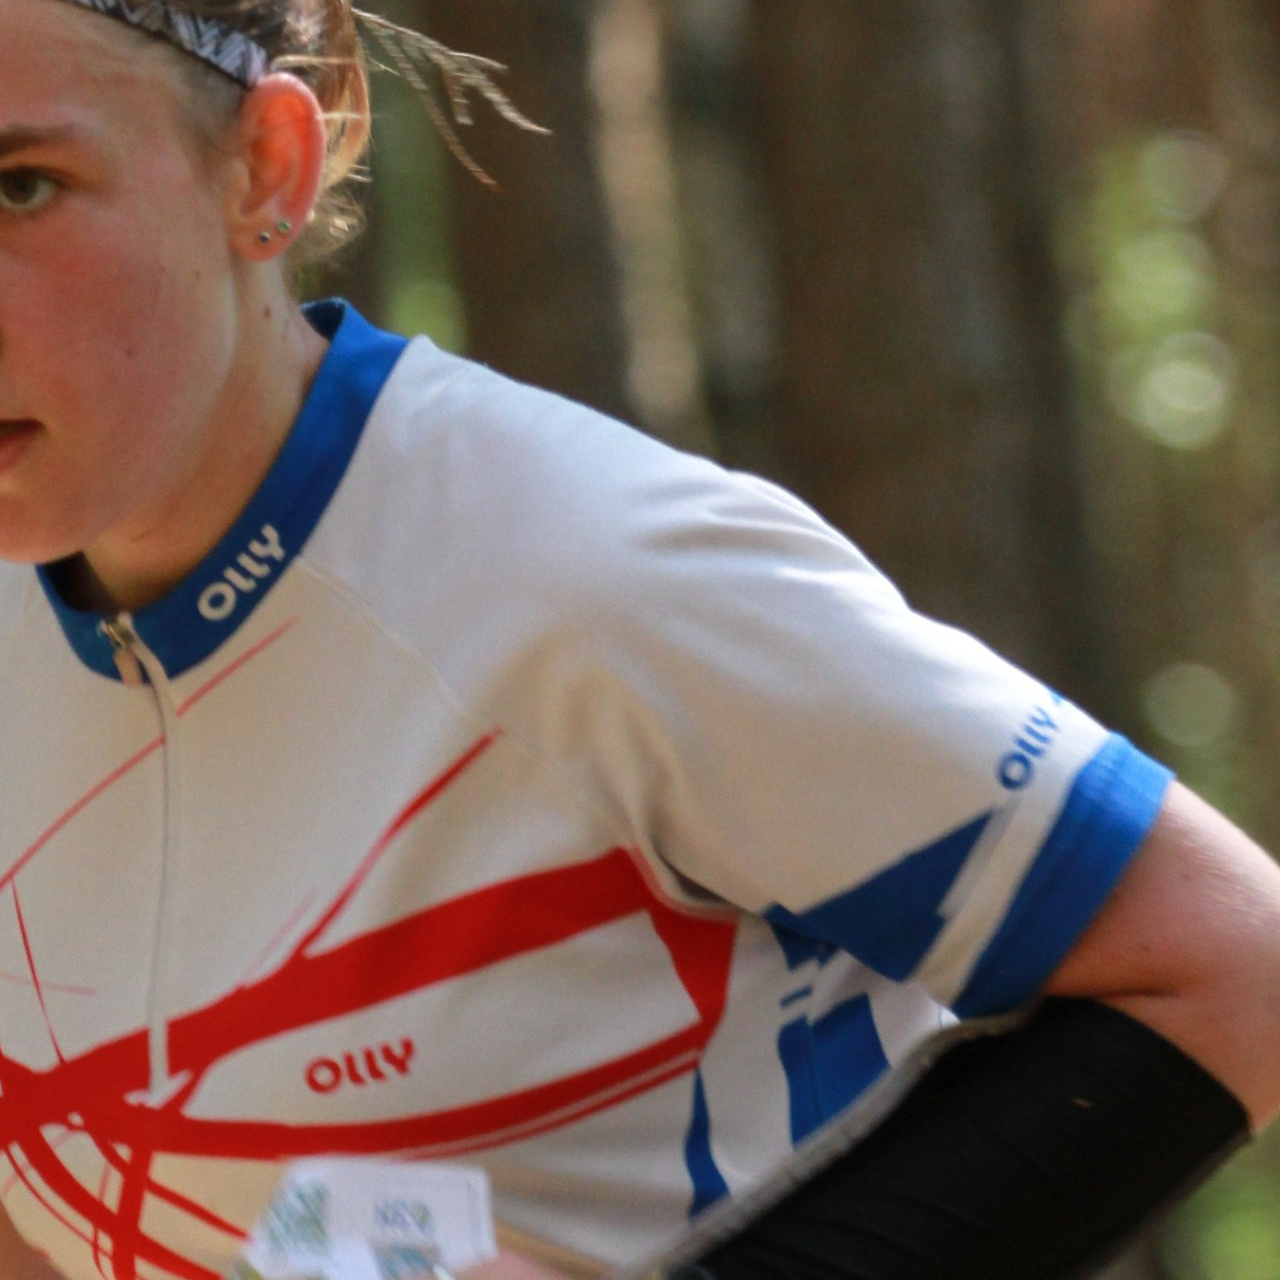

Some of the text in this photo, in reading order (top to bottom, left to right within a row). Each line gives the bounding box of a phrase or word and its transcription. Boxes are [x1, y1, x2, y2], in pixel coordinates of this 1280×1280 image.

[197, 523, 285, 621] OLLY
[997, 704, 1058, 790] OLLY
[305, 1037, 414, 1095] OLLY
